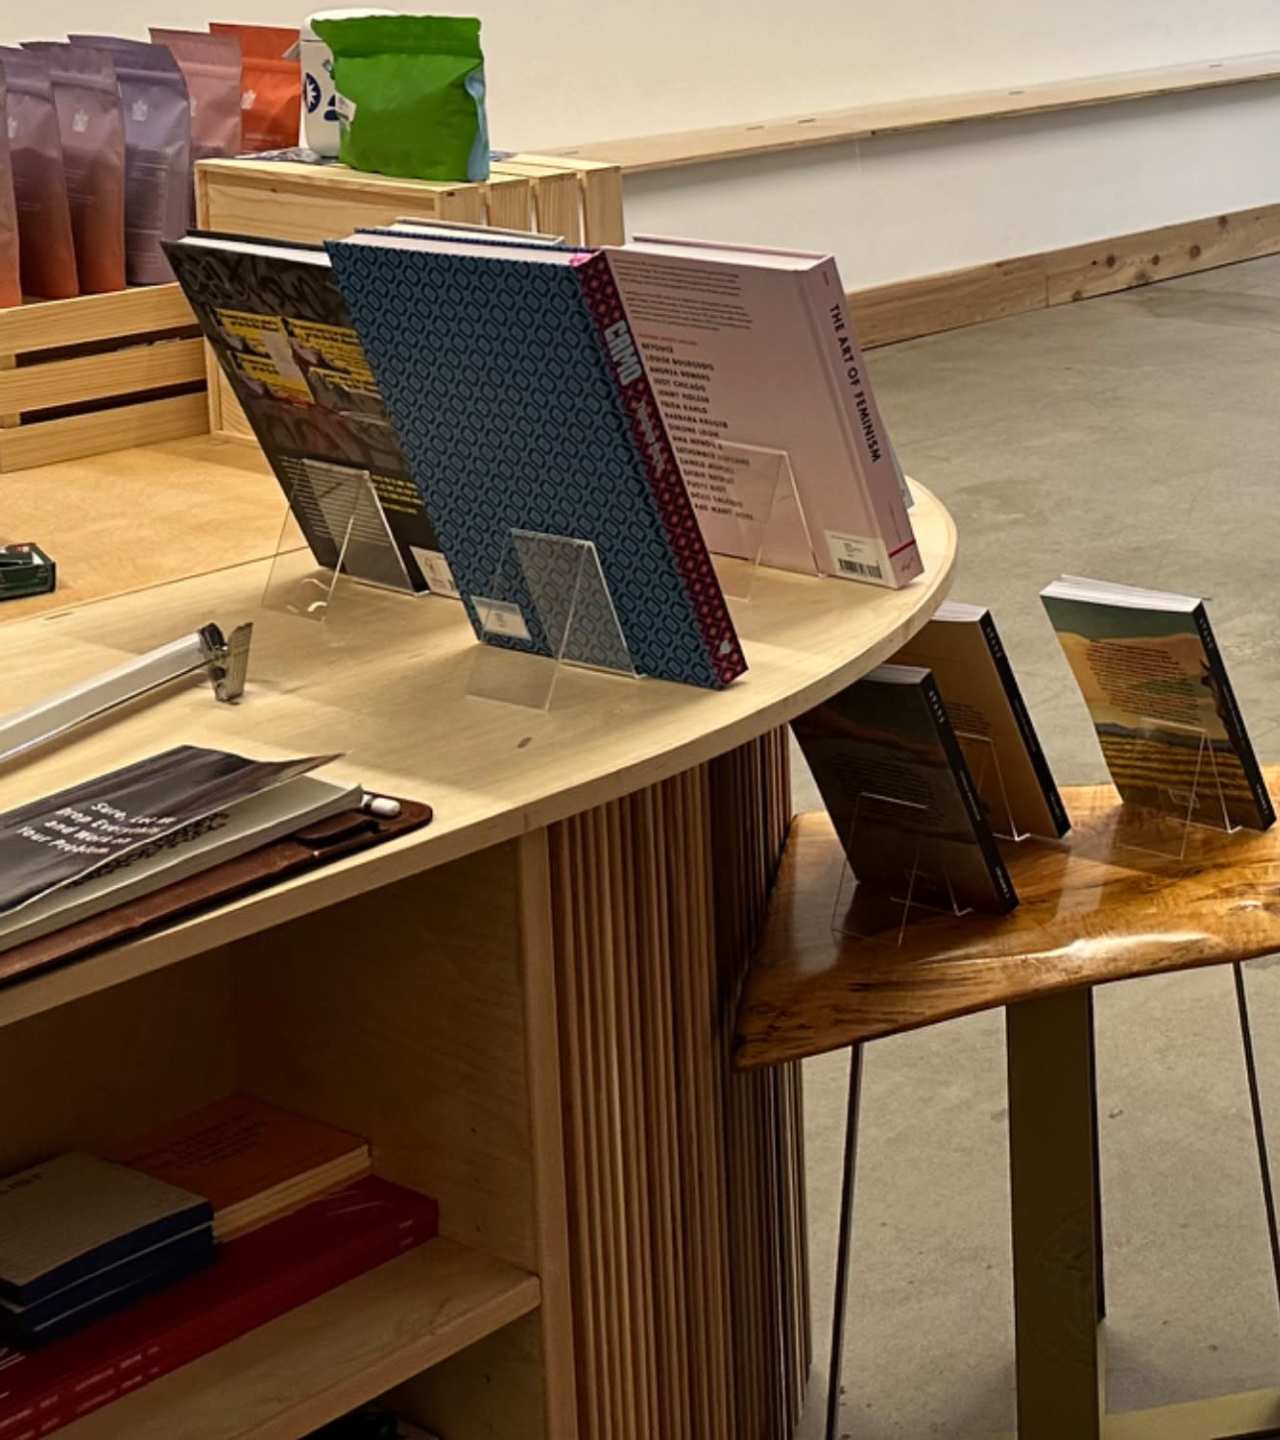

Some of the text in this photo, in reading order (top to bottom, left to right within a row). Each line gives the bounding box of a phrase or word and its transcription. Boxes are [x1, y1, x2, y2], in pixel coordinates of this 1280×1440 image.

[604, 319, 642, 386] CAMO
[830, 304, 881, 463] THE ART OF FEMINISM
